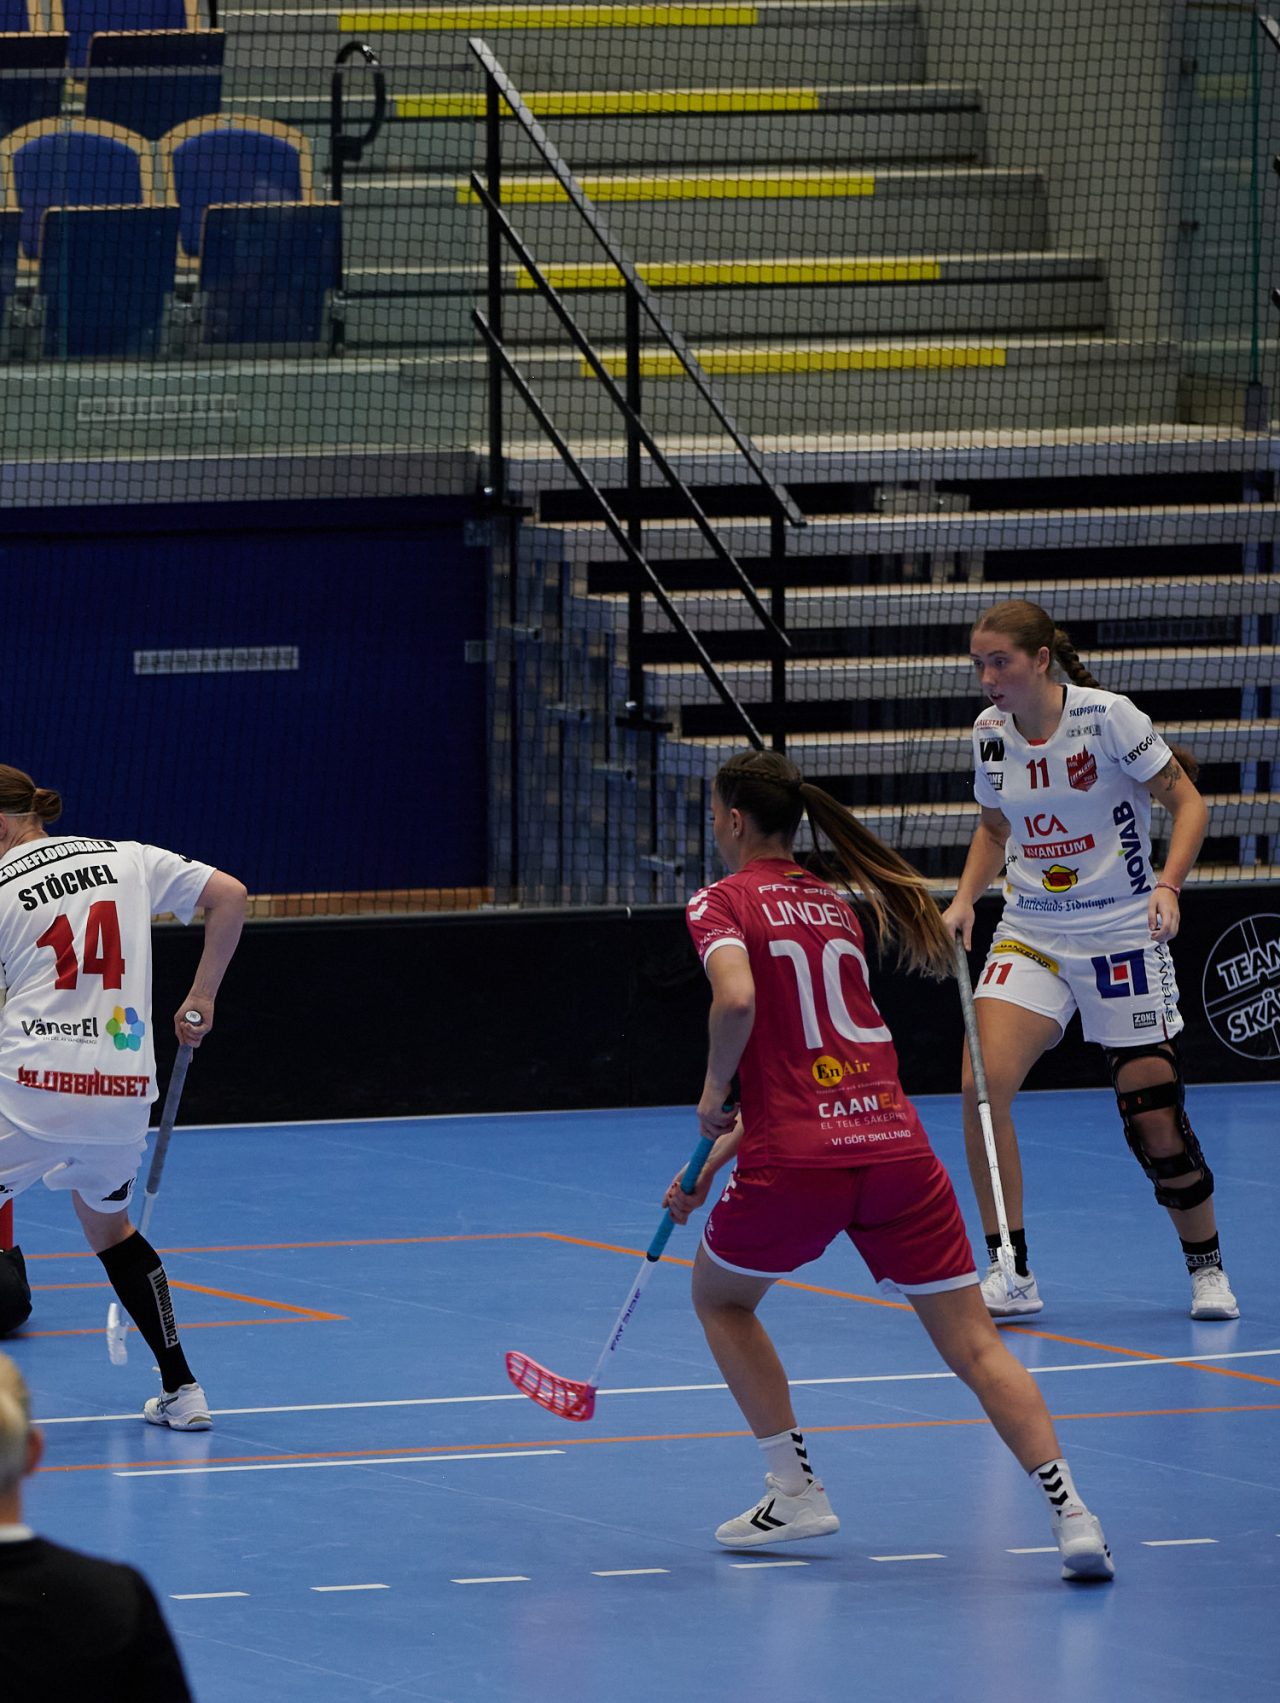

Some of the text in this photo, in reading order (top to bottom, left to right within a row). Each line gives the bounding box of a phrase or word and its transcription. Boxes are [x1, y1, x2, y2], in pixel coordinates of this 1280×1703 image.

[1026, 757, 1050, 790] 11
[1024, 813, 1069, 838] ICA
[1112, 800, 1152, 896] NOVAB
[17, 863, 119, 912] STÖCKEL
[761, 900, 858, 937] LINDELL
[36, 900, 126, 990] 14
[982, 962, 1013, 986] 11
[768, 938, 893, 1050] 10
[21, 1017, 99, 1038] VänerEl
[816, 1060, 870, 1080] EnAir
[836, 1118, 860, 1129] TELE
[831, 1137, 842, 1146] VI
[844, 1133, 866, 1145] GÖR
